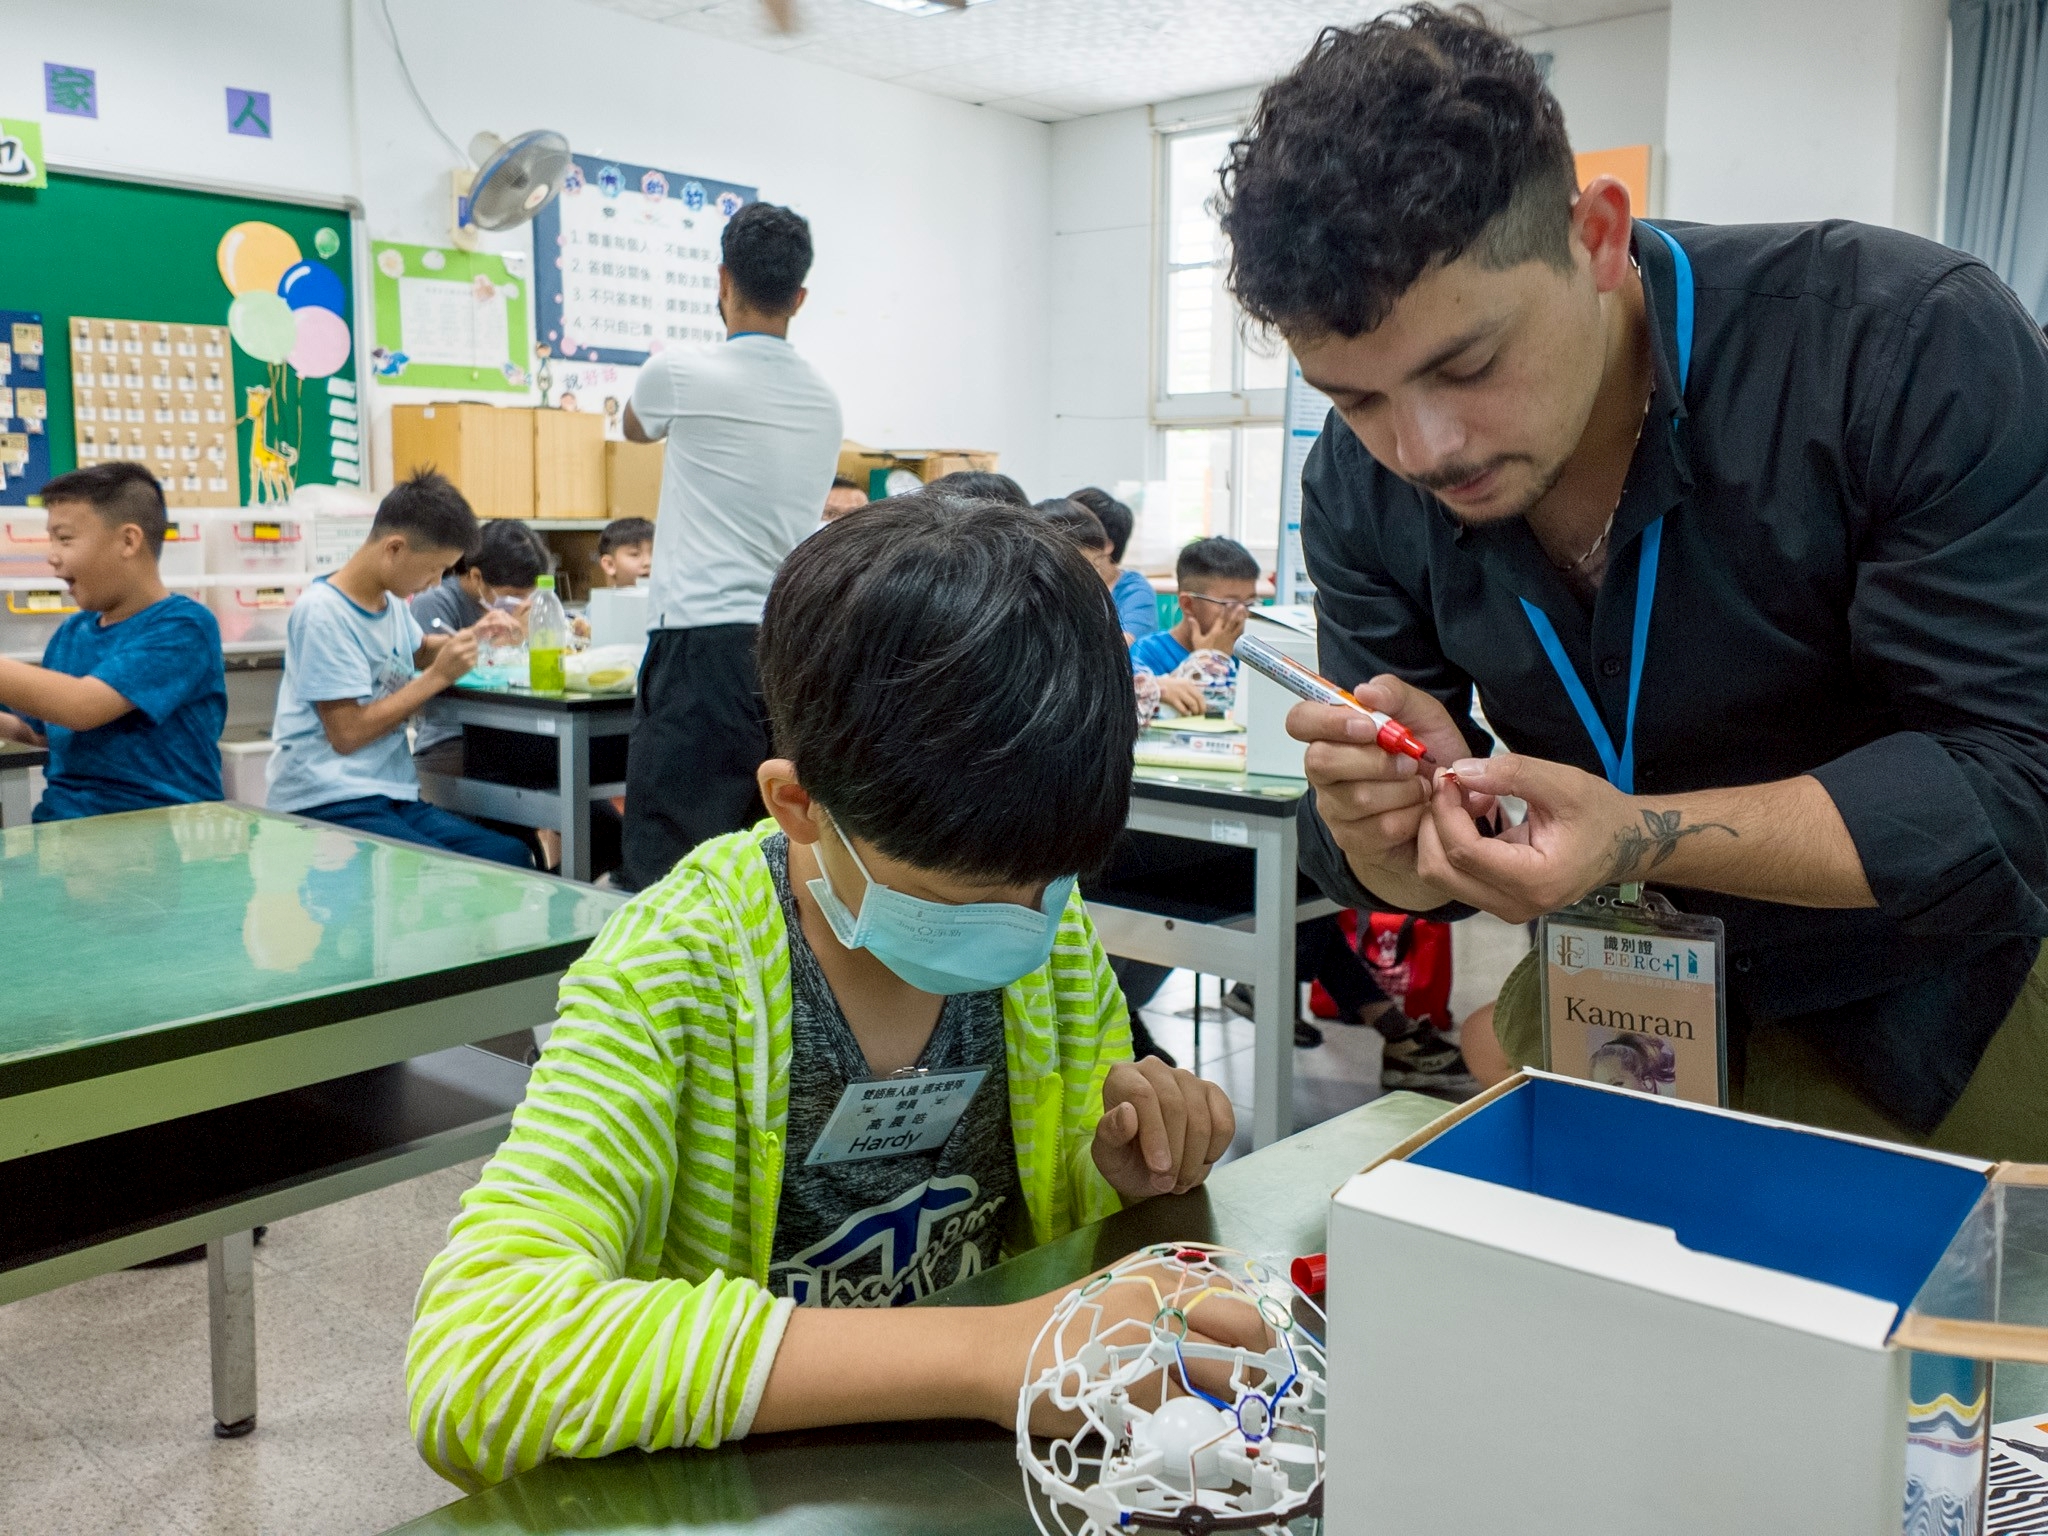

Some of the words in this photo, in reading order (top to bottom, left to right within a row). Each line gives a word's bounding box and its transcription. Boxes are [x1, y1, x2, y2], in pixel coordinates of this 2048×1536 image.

[51, 66, 95, 111] 家
[233, 95, 270, 135] 人
[1603, 935, 1653, 956] 識別證
[1564, 996, 1696, 1041] Kamran
[848, 1130, 923, 1154] Hardy
